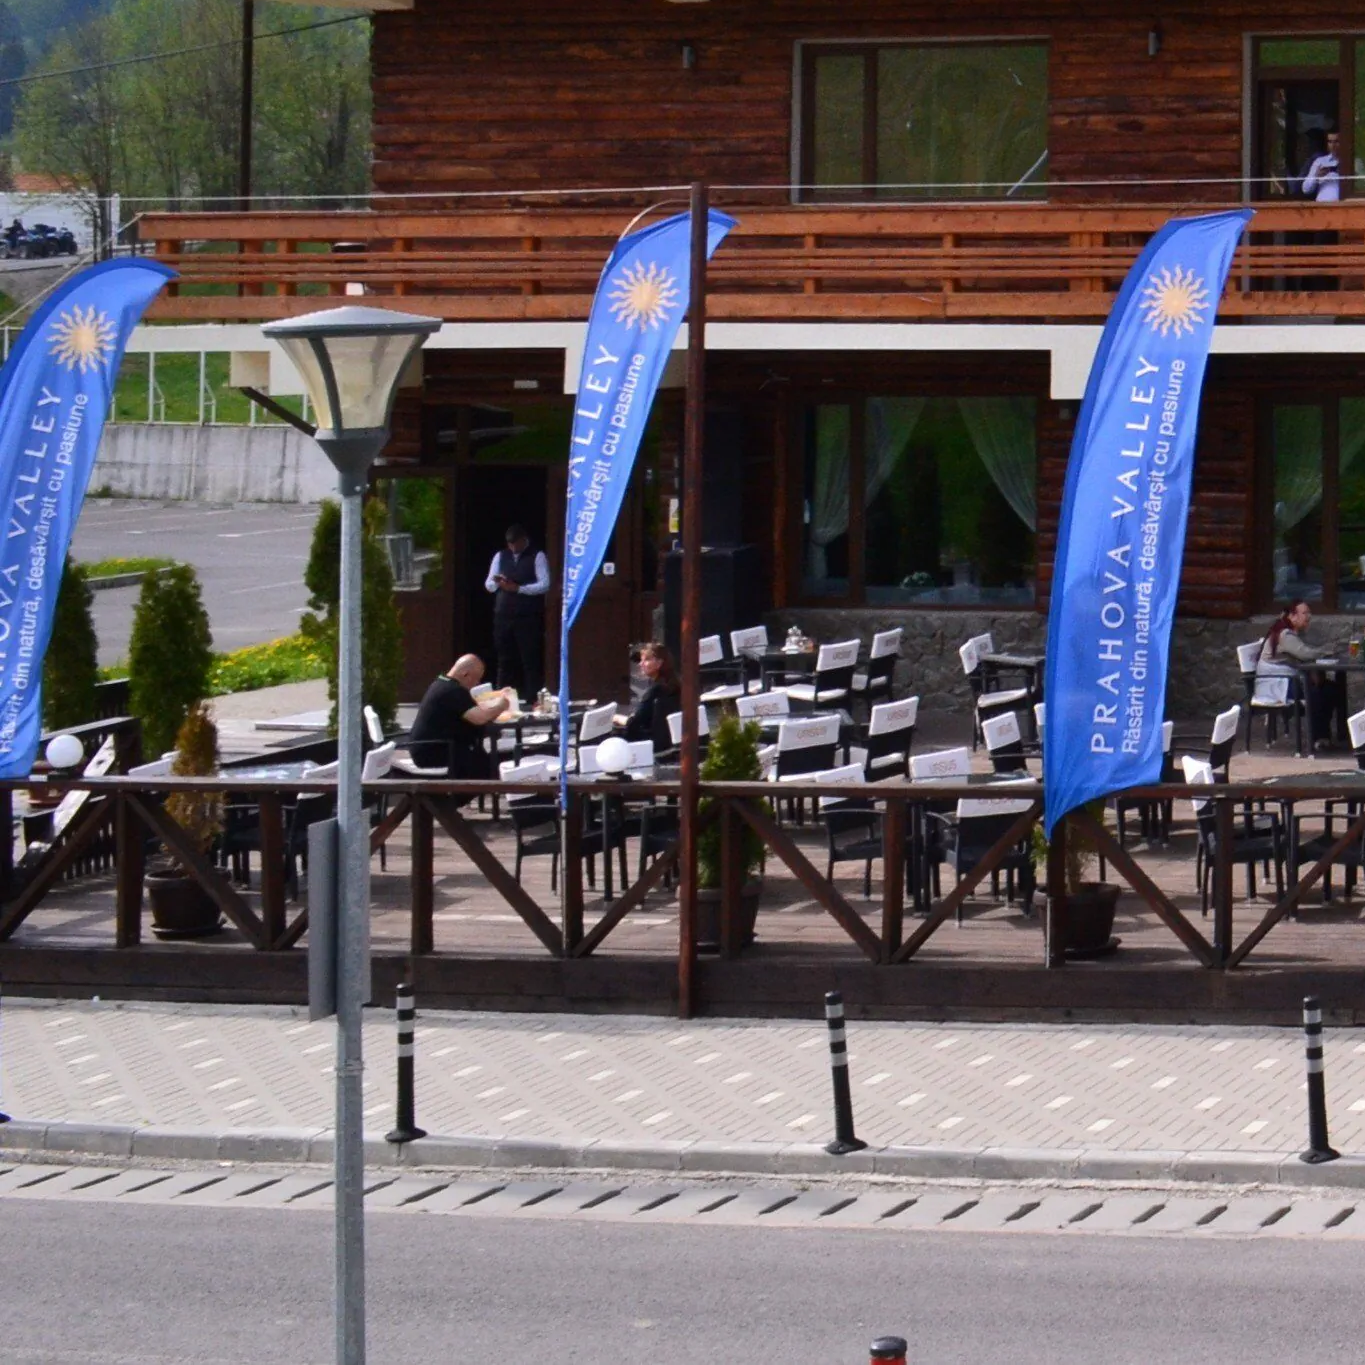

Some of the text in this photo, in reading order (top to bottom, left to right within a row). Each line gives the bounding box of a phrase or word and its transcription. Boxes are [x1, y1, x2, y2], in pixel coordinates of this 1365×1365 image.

[567, 344, 620, 499] ALLEY
[610, 352, 646, 429] pasiune
[1160, 359, 1186, 436] pasiune
[8, 386, 62, 539] VALLEY
[56, 392, 89, 466] pasiune
[602, 432, 621, 456] cu
[1154, 441, 1171, 465] cu
[48, 468, 65, 493] cu
[1091, 356, 1160, 754] PRAHOVA VALLEY
[14, 659, 30, 690] din
[1129, 649, 1148, 681] din
